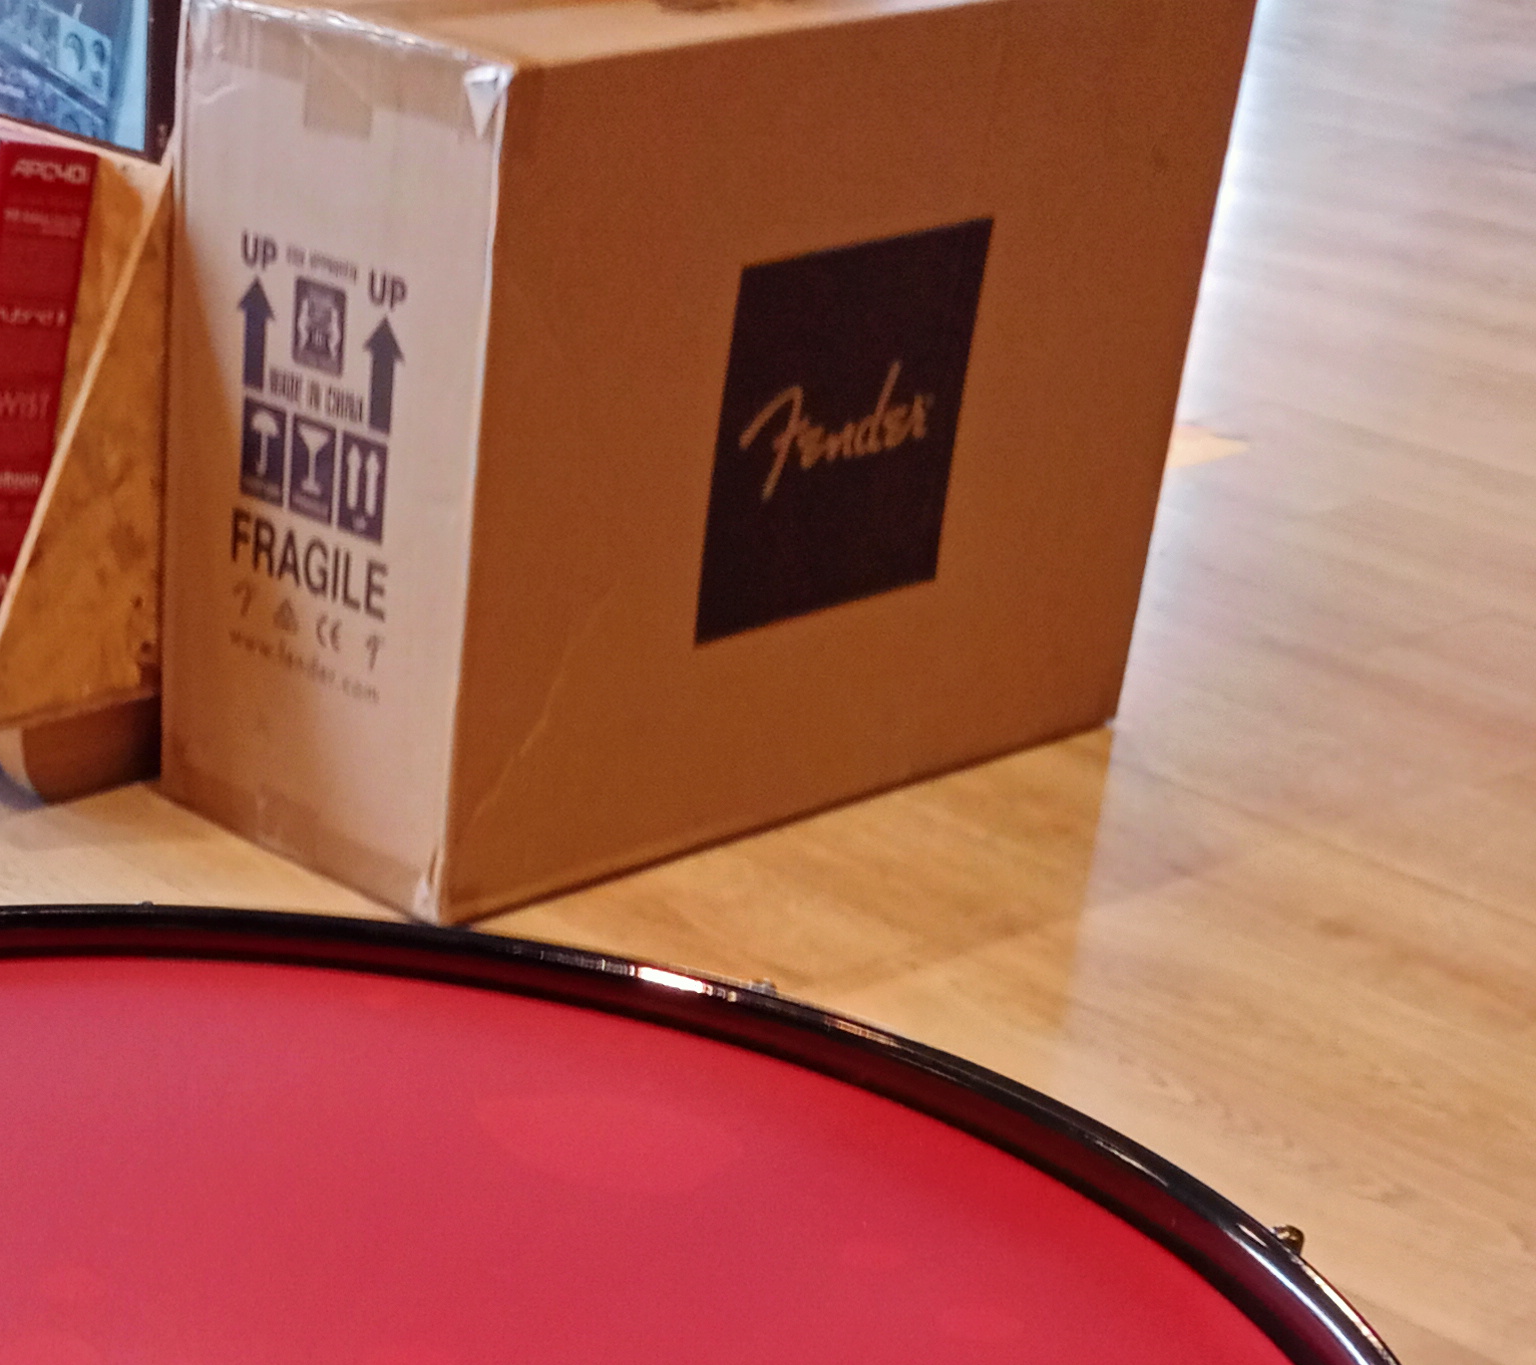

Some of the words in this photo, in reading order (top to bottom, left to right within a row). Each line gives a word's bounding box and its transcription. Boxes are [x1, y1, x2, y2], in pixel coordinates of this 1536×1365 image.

[241, 228, 278, 271] UP
[367, 266, 407, 311] UP
[739, 359, 928, 502] Fender
[230, 507, 389, 623] FRAGILE
